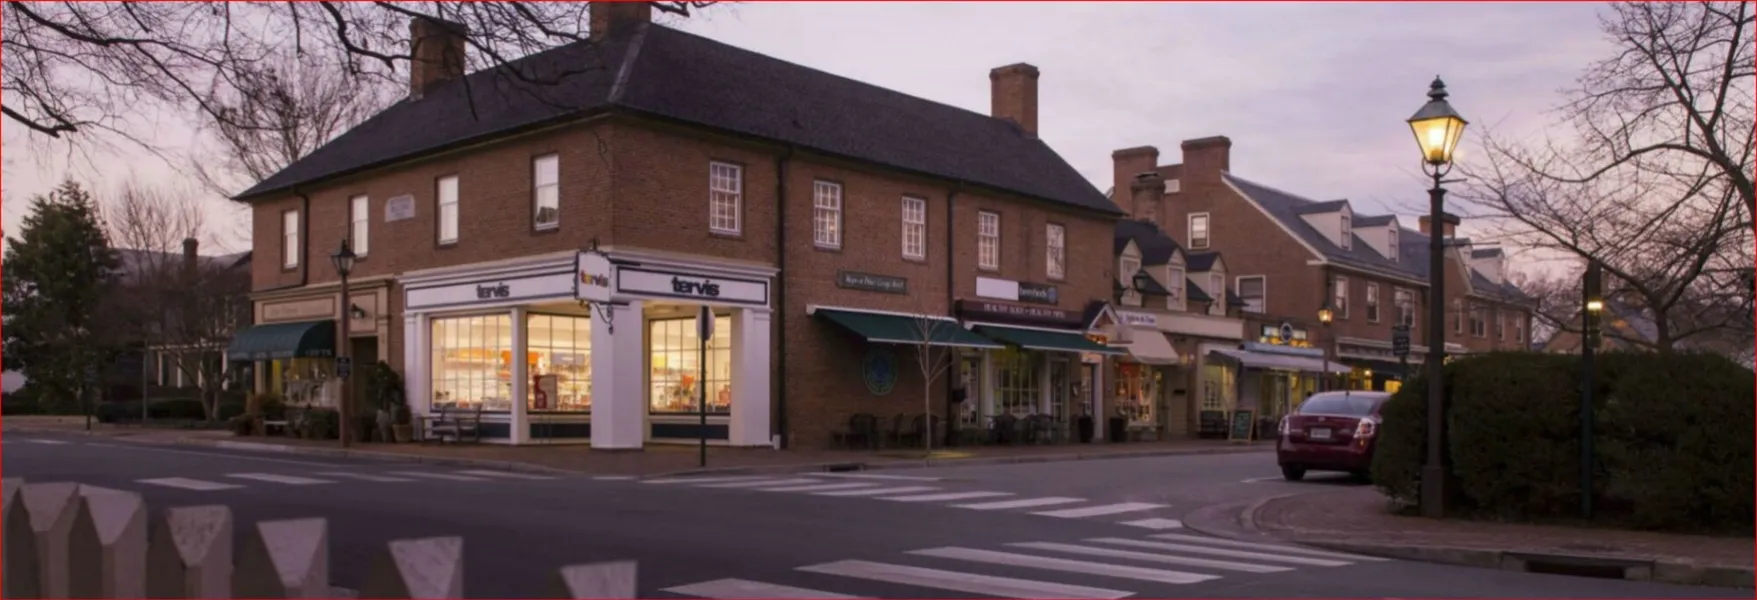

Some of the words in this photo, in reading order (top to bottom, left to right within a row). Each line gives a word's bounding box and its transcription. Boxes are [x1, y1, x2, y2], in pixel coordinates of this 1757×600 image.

[580, 269, 609, 288] tervis
[671, 276, 720, 296] tervis
[476, 281, 510, 299] tervis
